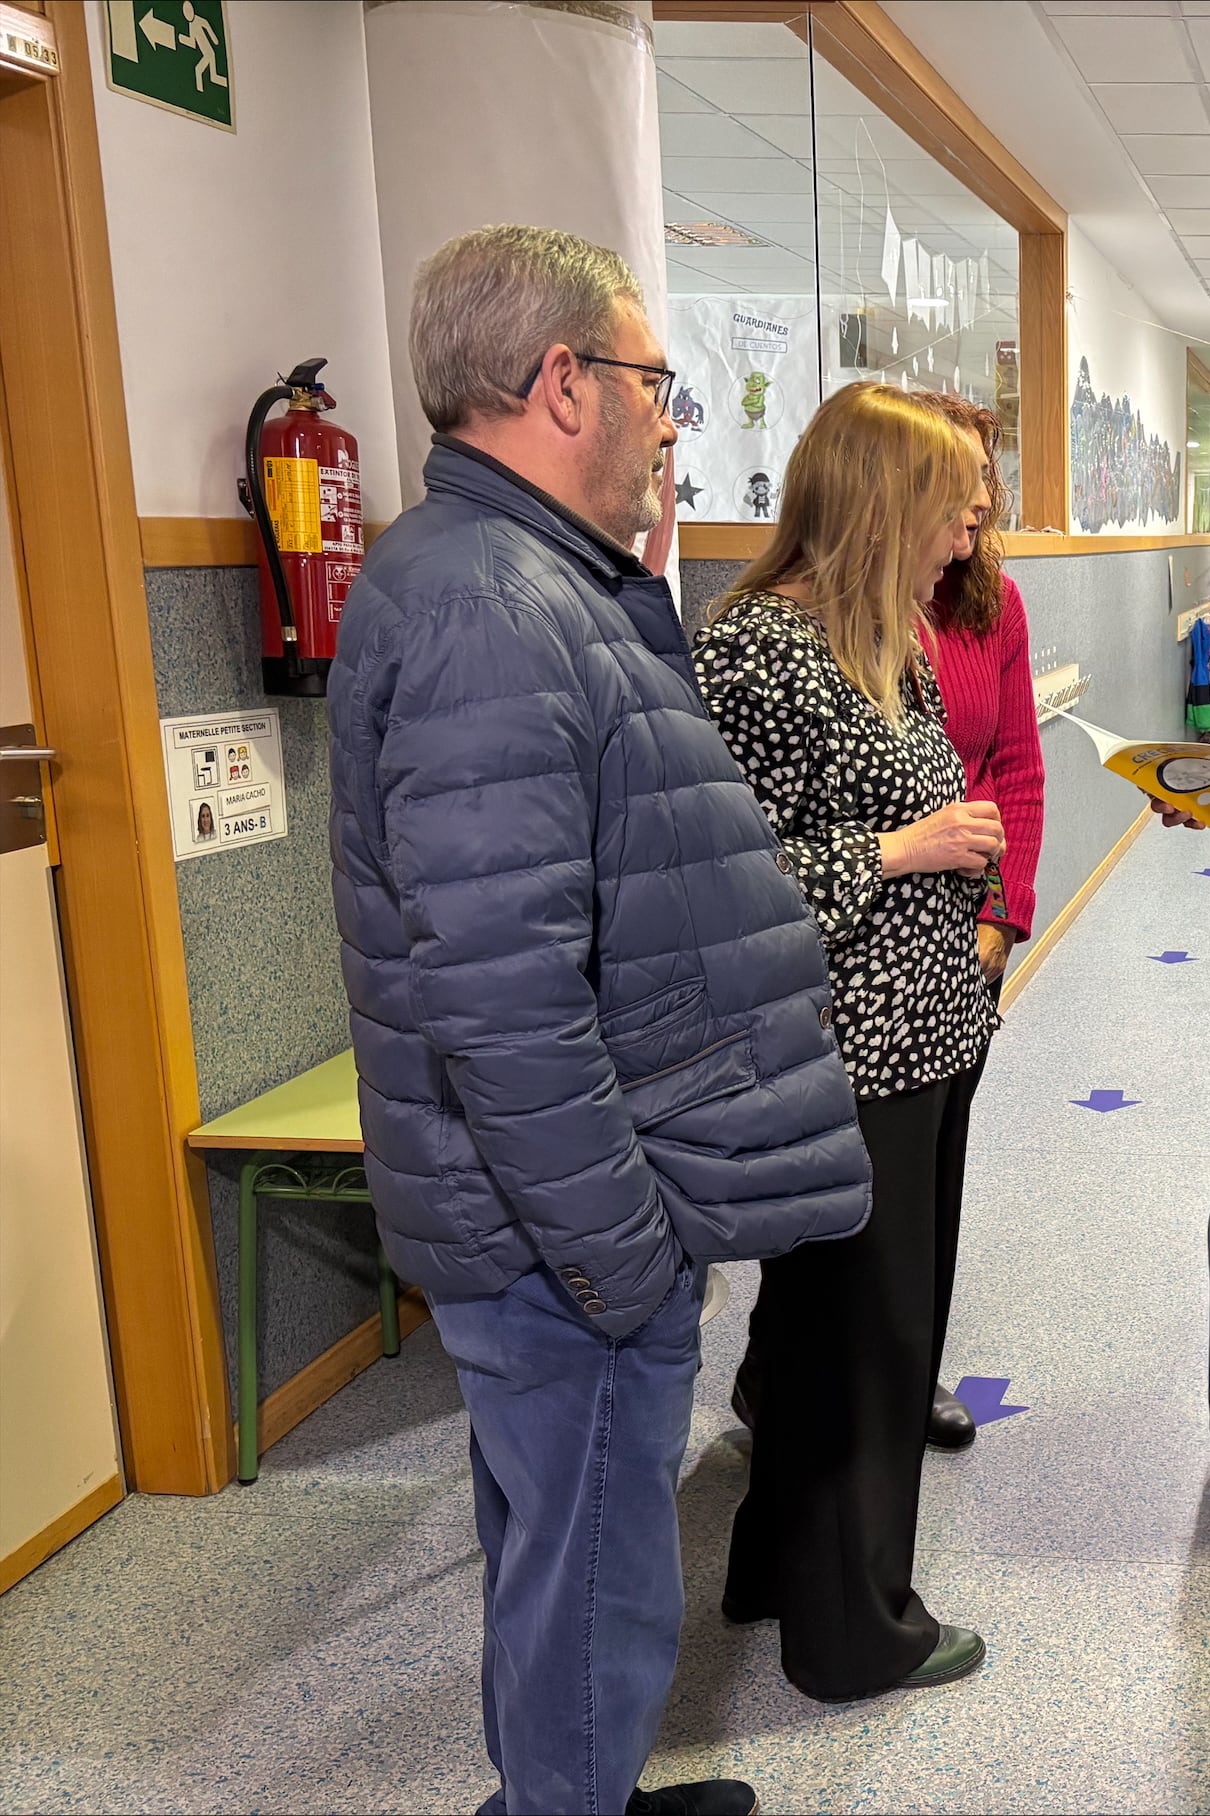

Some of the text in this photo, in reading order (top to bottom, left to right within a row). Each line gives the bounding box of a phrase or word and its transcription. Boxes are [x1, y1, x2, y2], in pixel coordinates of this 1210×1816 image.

[733, 313, 789, 336] GUARDIANES
[749, 342, 782, 351] CUENTOS
[320, 468, 351, 478] EXTINTOR
[179, 722, 266, 740] MATERNELLE PETITE SECTION
[226, 788, 265, 805] MARIA CACHO
[224, 823, 231, 836] 3
[260, 816, 267, 829] B
